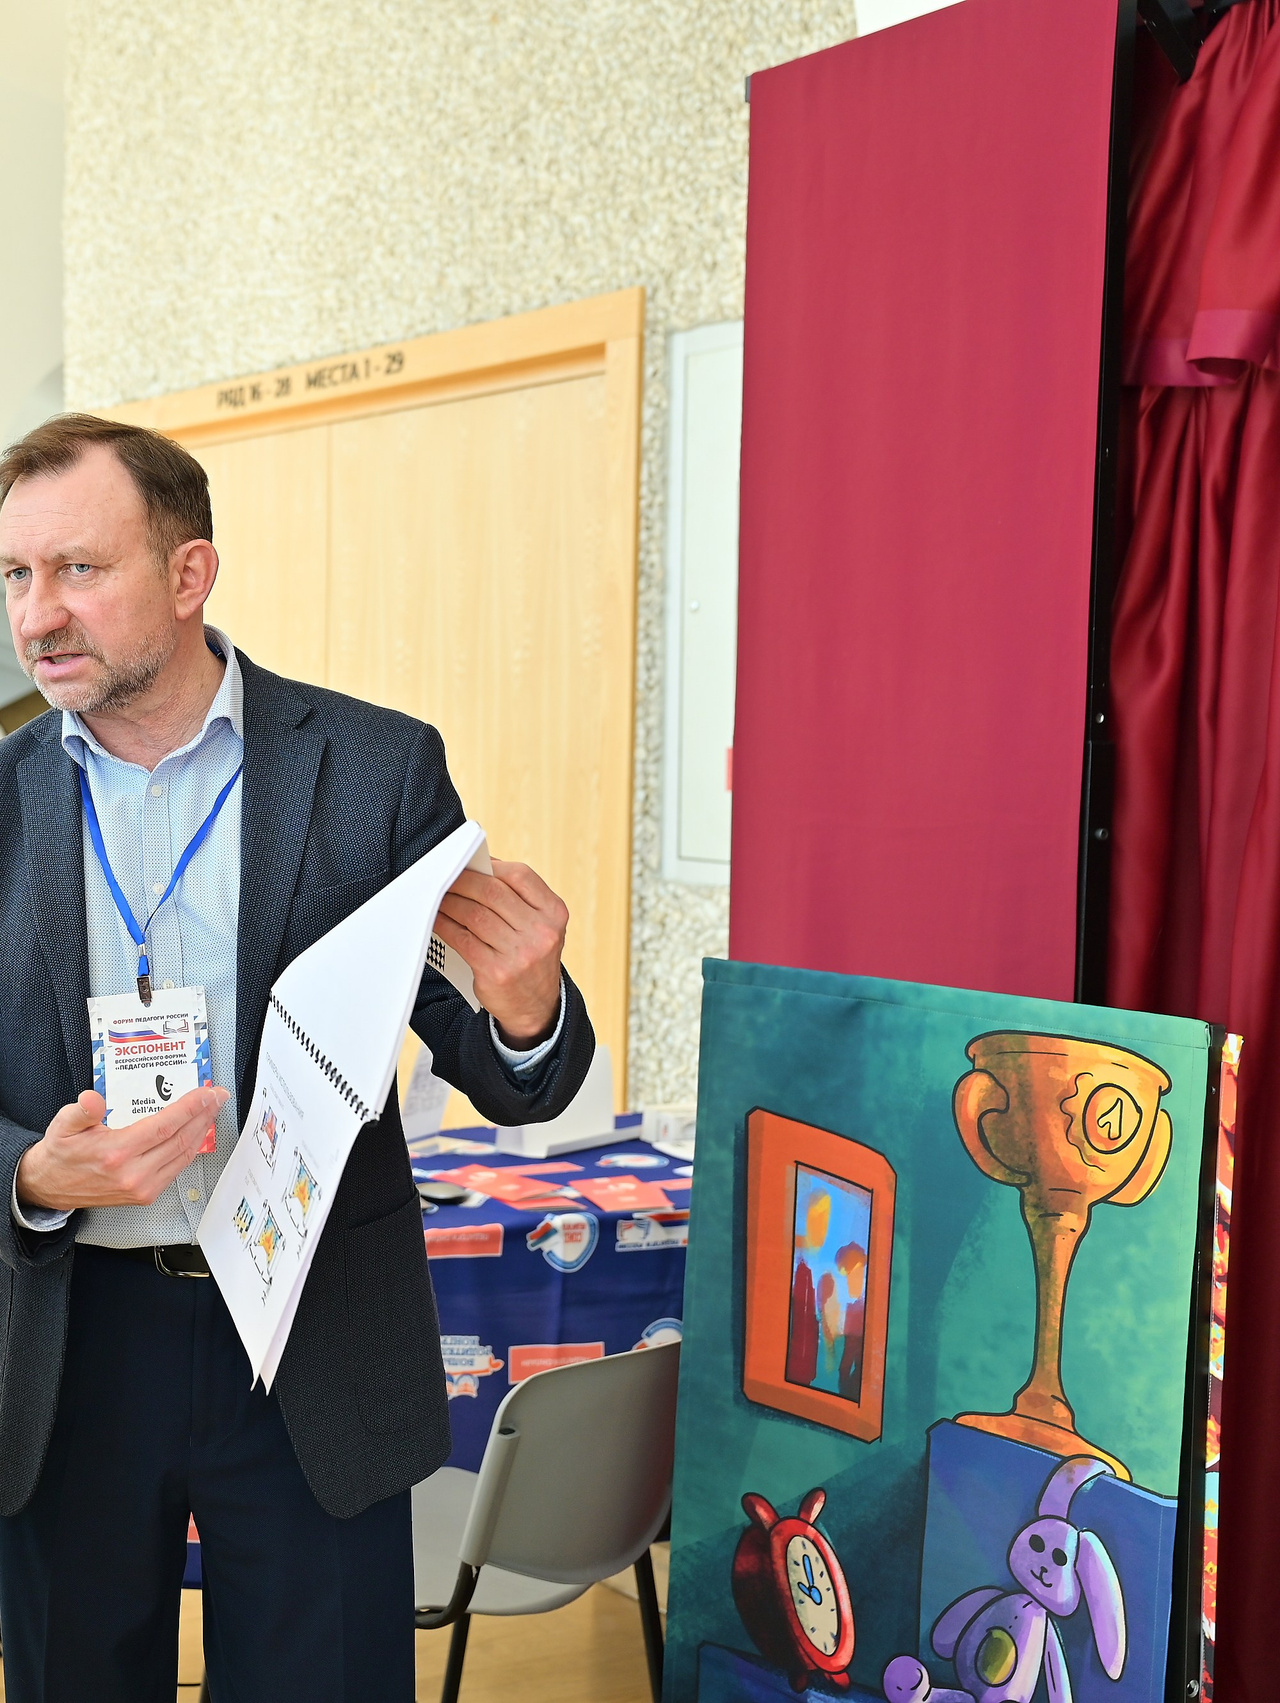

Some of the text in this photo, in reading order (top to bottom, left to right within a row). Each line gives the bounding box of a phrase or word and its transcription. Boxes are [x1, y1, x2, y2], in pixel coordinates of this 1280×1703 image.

[217, 385, 245, 408] РЯД
[306, 360, 360, 390] МЕСТА
[384, 350, 405, 375] 29
[135, 1015, 164, 1023] ПЕДАГОГИ
[114, 1041, 186, 1056] ЭКСПОНЕНТ
[115, 1056, 164, 1064] ВСЕРОССИЙСКОГО
[131, 1097, 156, 1106] Media
